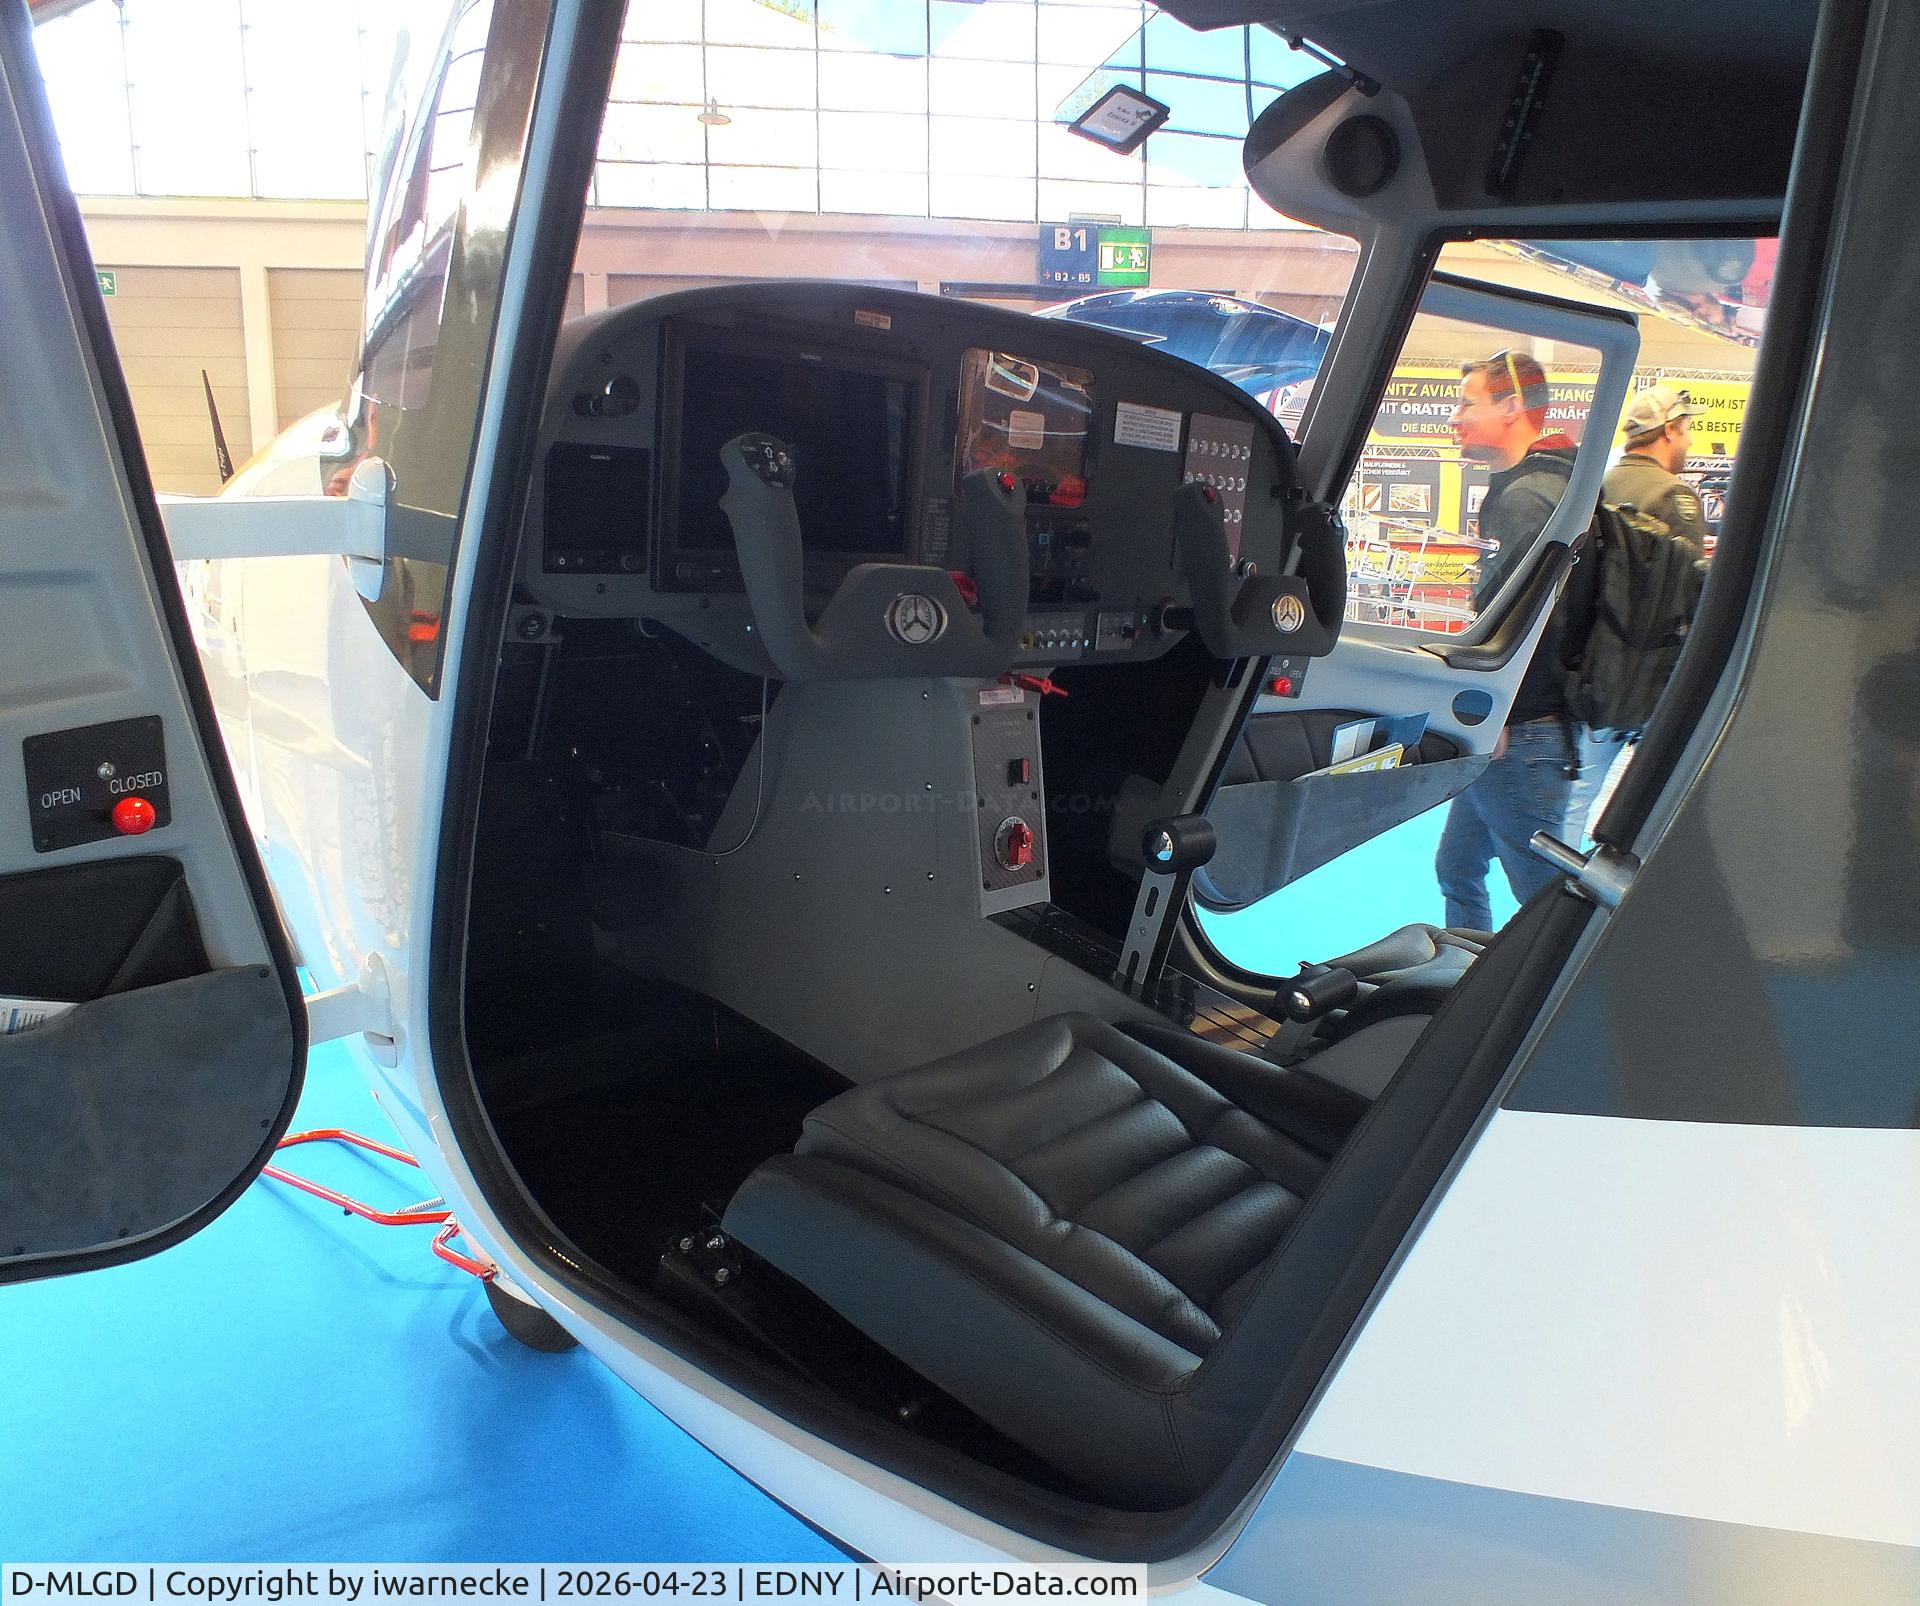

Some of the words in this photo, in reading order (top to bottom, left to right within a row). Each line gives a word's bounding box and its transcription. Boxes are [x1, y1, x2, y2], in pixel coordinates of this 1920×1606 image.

[1055, 228, 1087, 252] B1
[1055, 272, 1069, 282] B2
[1078, 273, 1091, 283] B5
[1385, 382, 1418, 397] NITZ
[1728, 399, 1746, 410] IST
[1401, 422, 1419, 433] DIE
[1706, 421, 1742, 433] BESTE
[110, 771, 163, 794] CLOSED
[41, 787, 81, 809] OPEN
